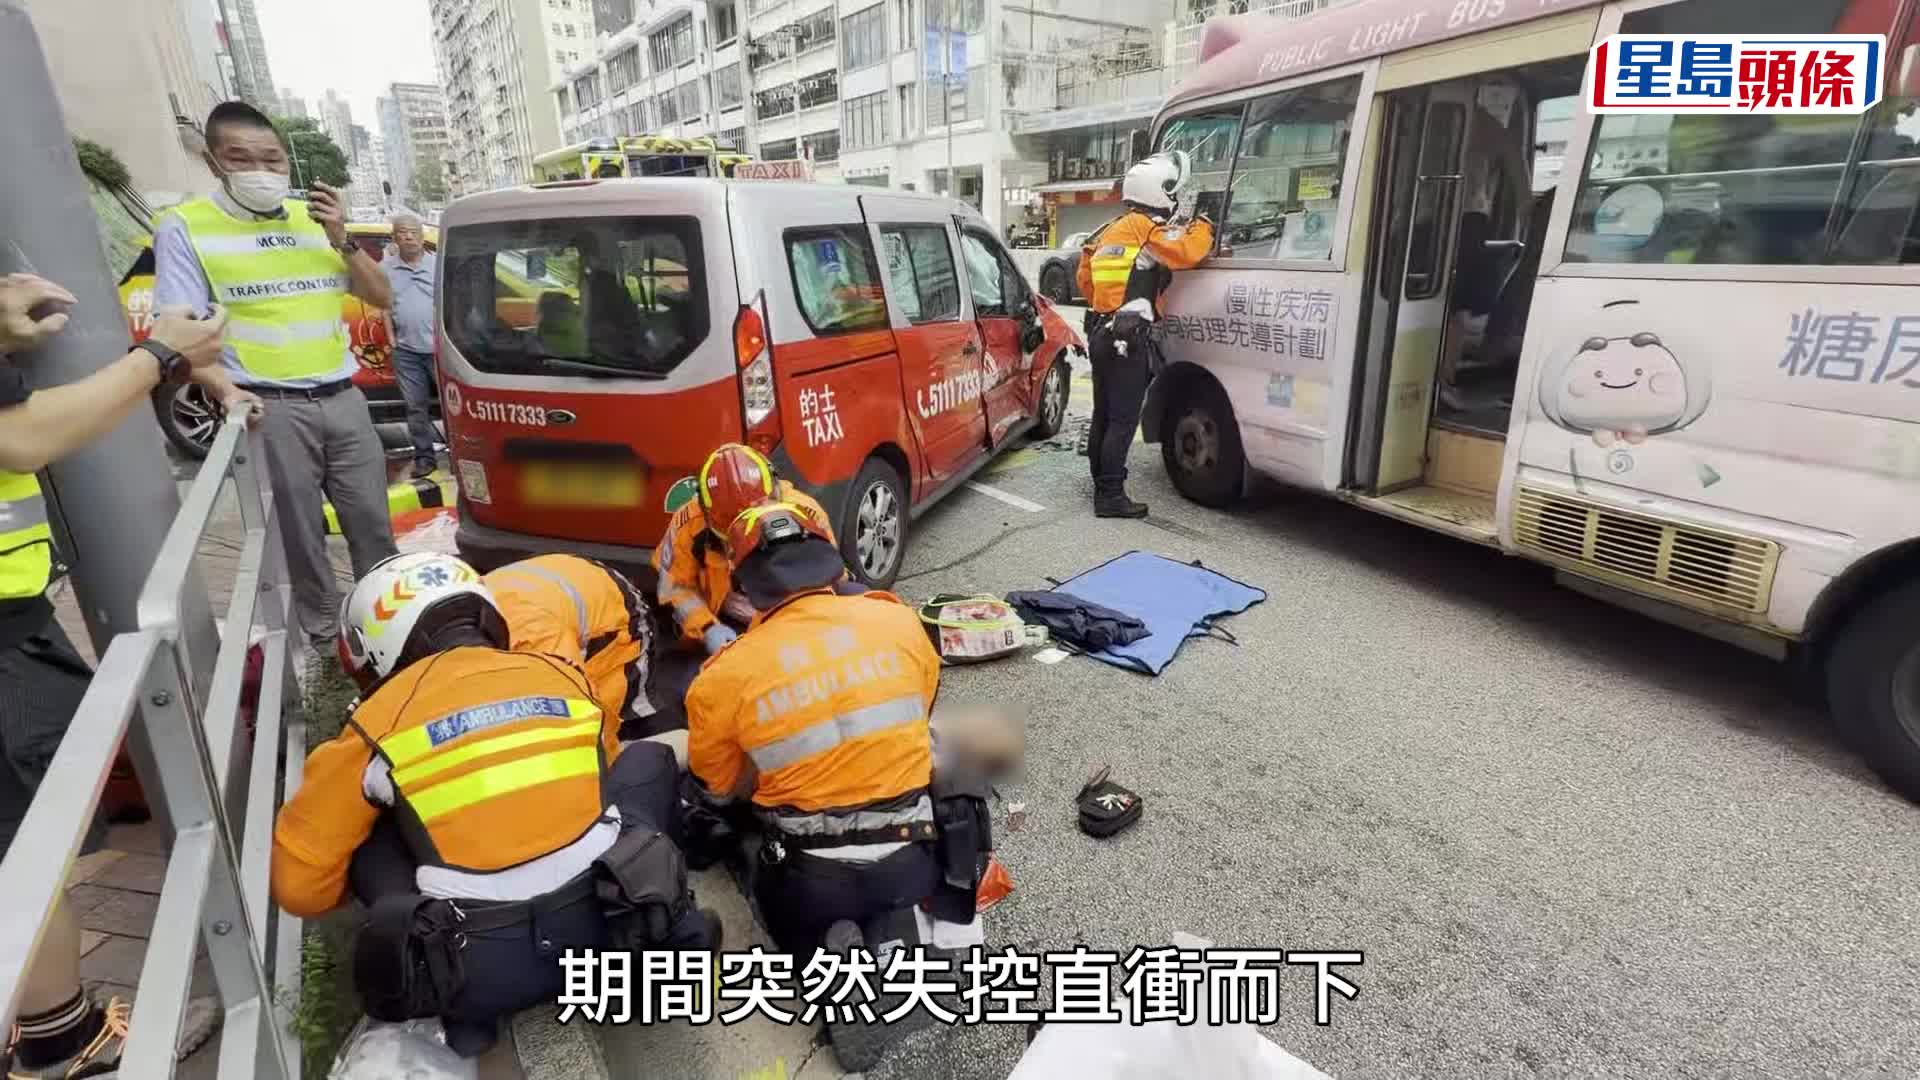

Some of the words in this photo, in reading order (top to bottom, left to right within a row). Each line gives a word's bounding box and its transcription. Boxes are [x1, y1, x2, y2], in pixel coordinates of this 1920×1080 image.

[1257, 35, 1336, 77] PUBLIC
[1348, 12, 1424, 53] LIGHT
[1446, 0, 1506, 29] BUS
[737, 161, 804, 180] TAXI
[227, 284, 286, 297] TRAFFIC
[1225, 284, 1333, 324] 慢性疾病
[799, 384, 836, 416] 的士
[803, 413, 844, 448] TAXI
